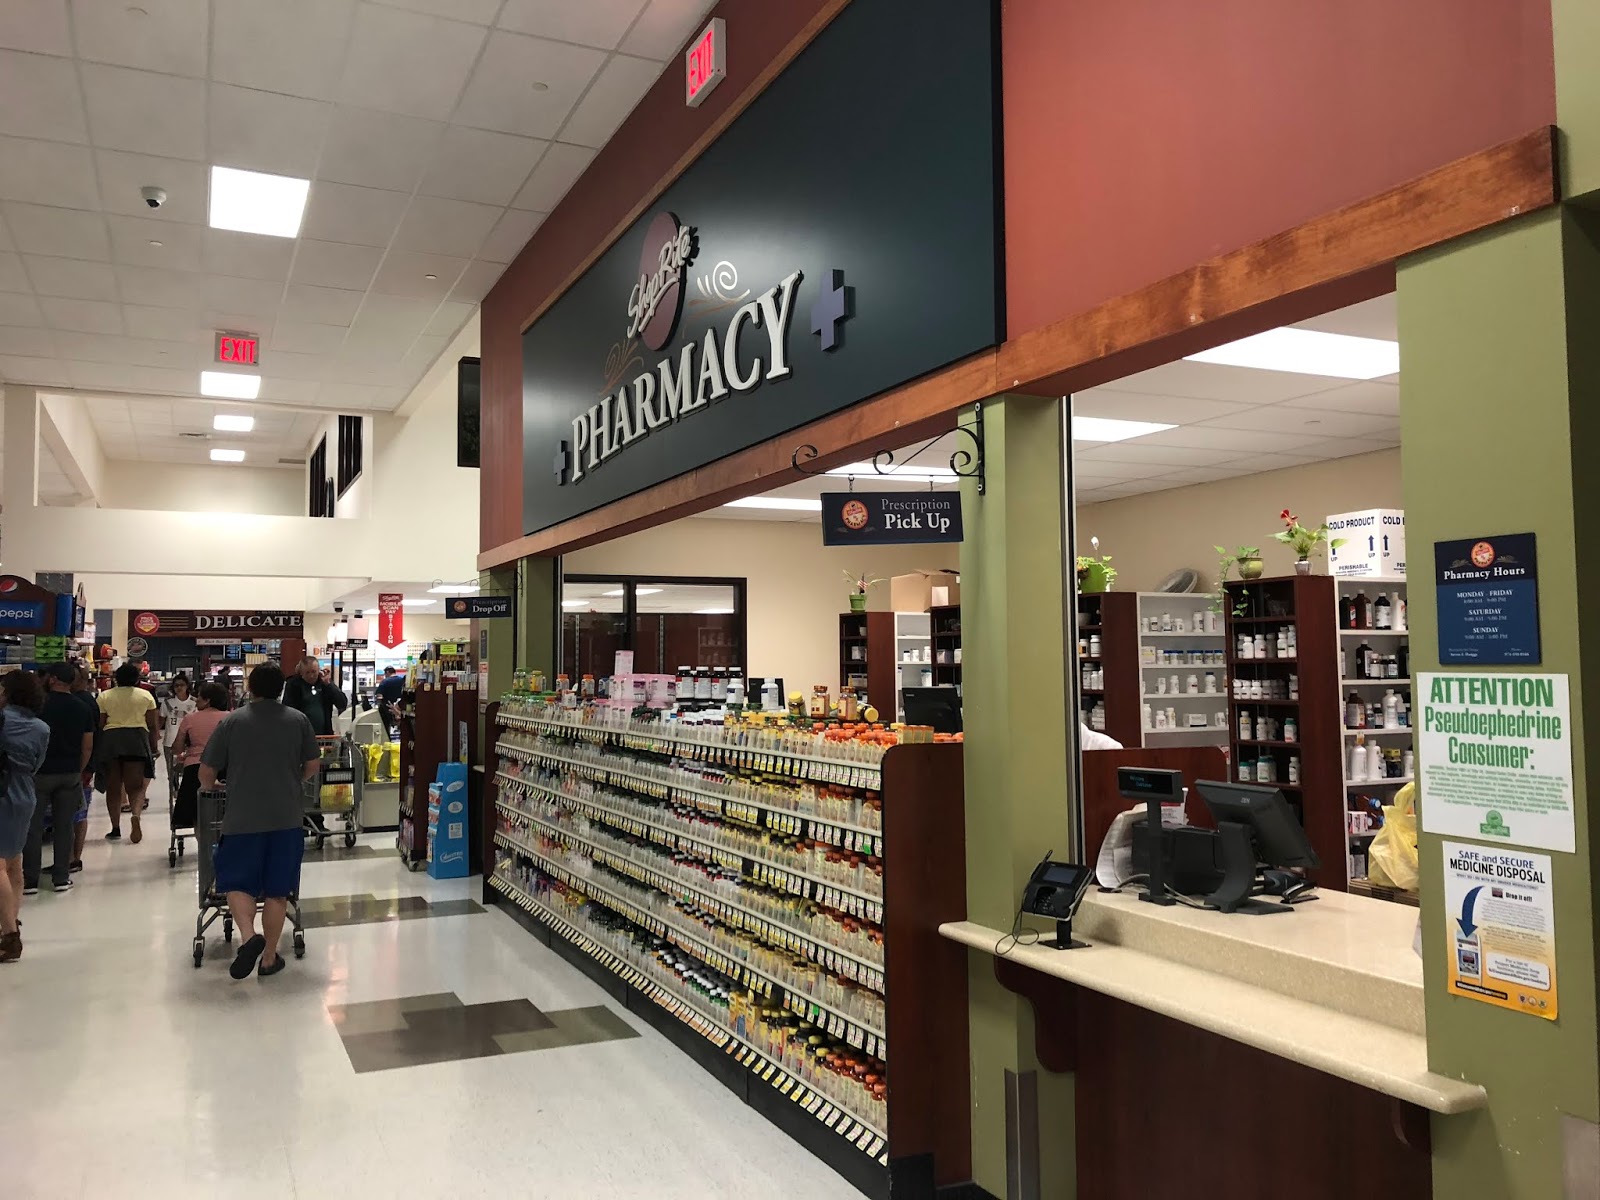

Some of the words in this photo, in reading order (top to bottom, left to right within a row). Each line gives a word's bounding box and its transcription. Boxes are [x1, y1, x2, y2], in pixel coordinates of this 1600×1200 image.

[689, 29, 713, 96] EXIT
[627, 225, 692, 339] ShopRite
[220, 336, 256, 365] EXIT
[571, 269, 802, 483] PHARMACY
[881, 498, 951, 513] Prescription
[884, 512, 922, 530] Pick
[926, 512, 951, 533] Up
[1328, 520, 1345, 530] COLD
[1346, 516, 1375, 528] PRODUCT
[1382, 516, 1401, 525] COLD
[1338, 563, 1369, 571] PERISHABLE
[1444, 569, 1491, 580] Pharmacy
[1493, 567, 1525, 577] Hours
[1489, 589, 1513, 597] FRIDAY
[0, 609, 34, 620] pepsi
[472, 605, 493, 614] Drop
[493, 604, 508, 612] Off
[195, 615, 303, 630] DELICATE
[1430, 677, 1554, 707] ATTENTION
[1425, 706, 1562, 740] Pseudoephedrine
[1448, 736, 1535, 770] Consumer:
[1458, 850, 1480, 860] SAFE
[1481, 854, 1497, 864] and
[1499, 856, 1535, 869] SECURE
[1449, 858, 1495, 875] MEDICINE
[1496, 866, 1546, 884] DISPOSAL
[1505, 892, 1518, 901] Drop
